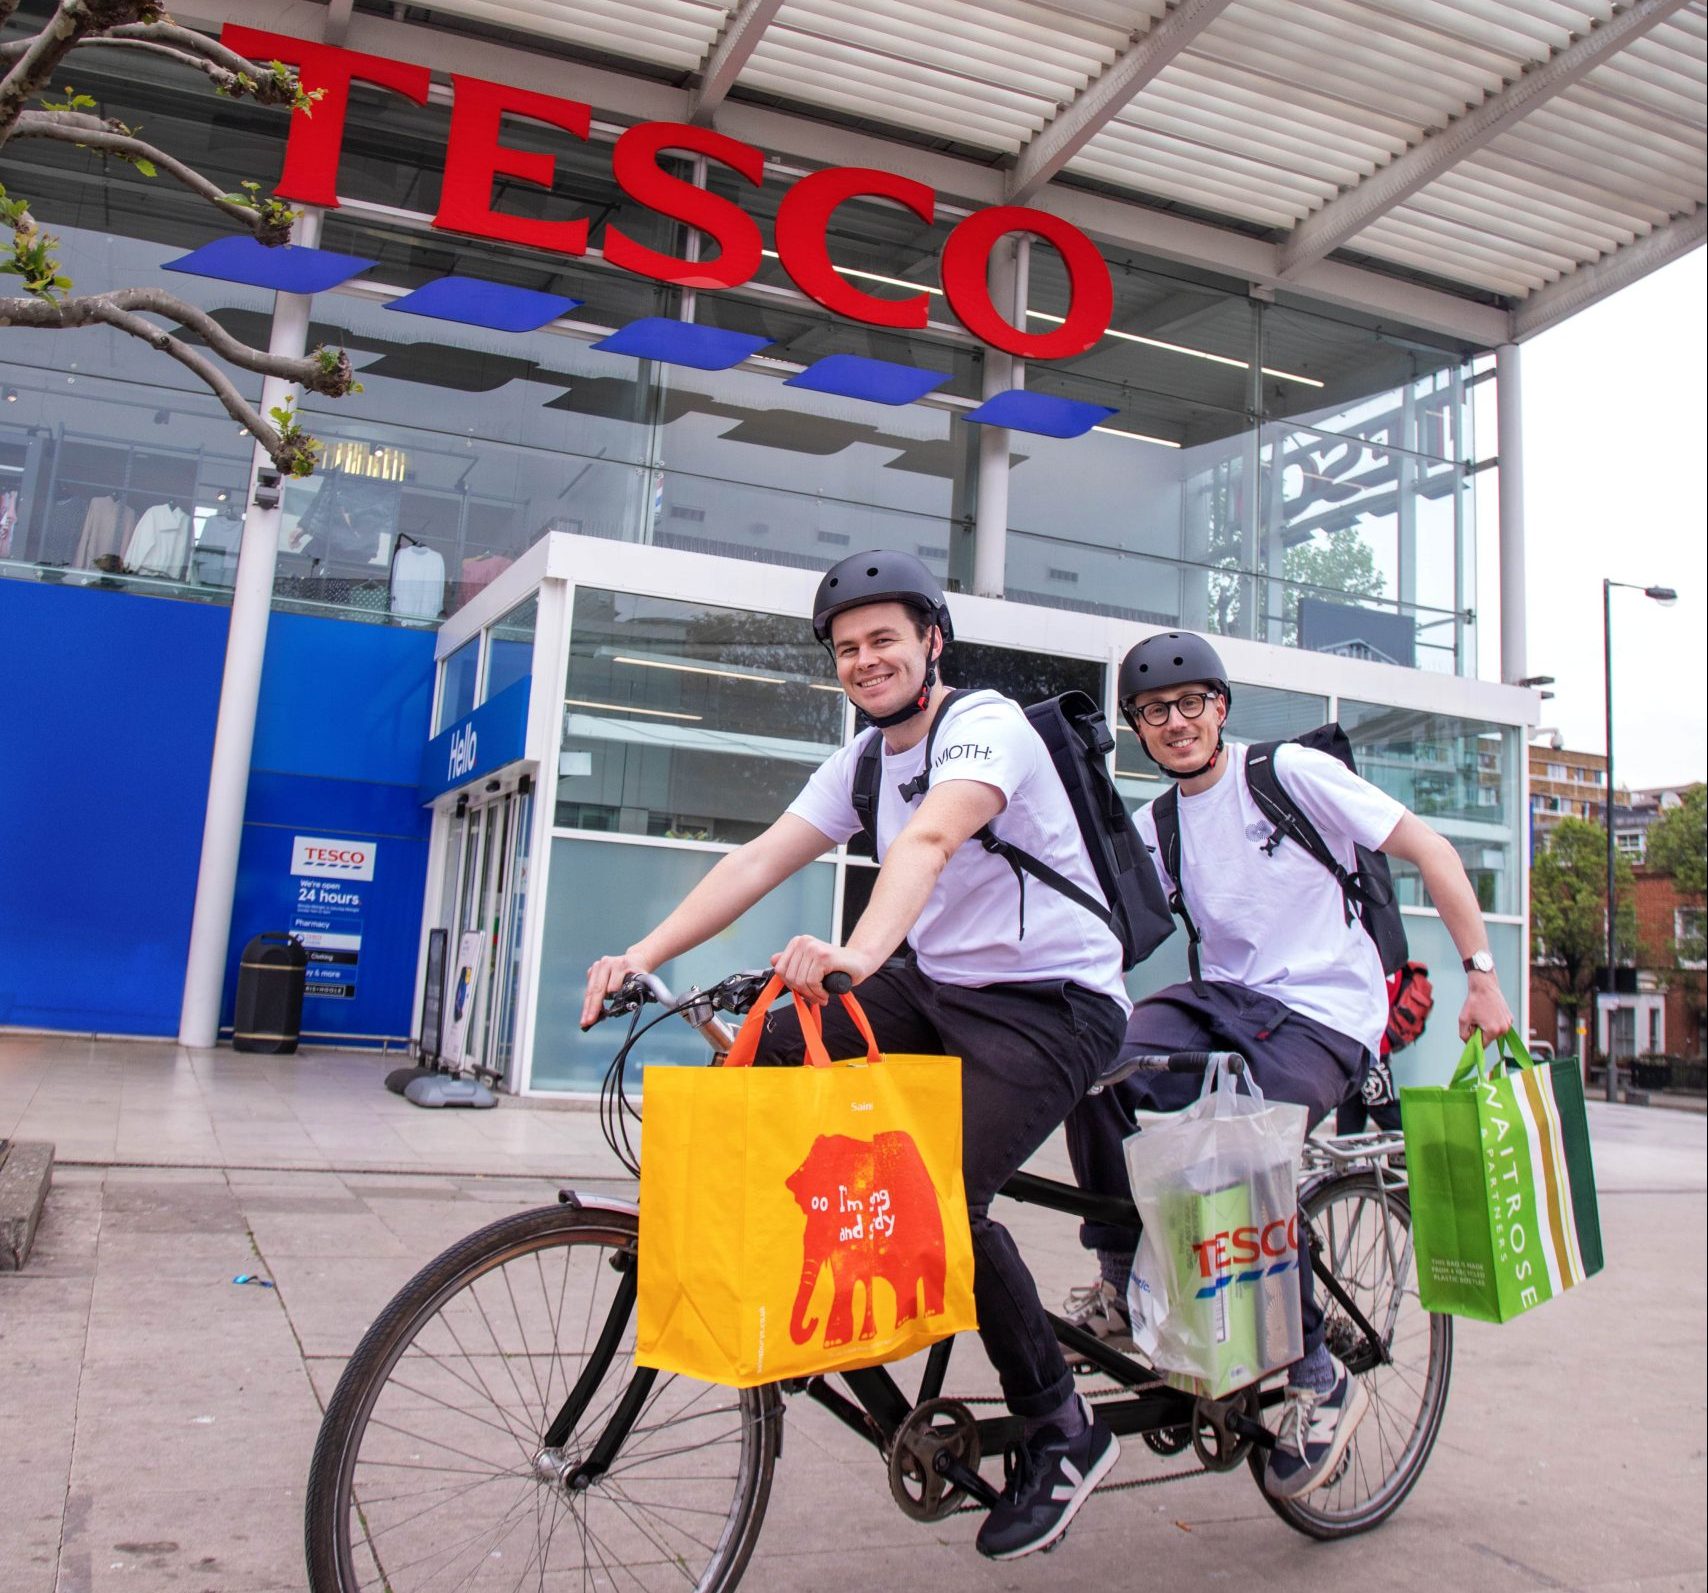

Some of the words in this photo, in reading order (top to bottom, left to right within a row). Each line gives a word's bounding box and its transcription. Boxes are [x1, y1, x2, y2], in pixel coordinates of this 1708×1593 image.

[221, 22, 1114, 360] TESCO
[304, 847, 365, 864] TESCO
[298, 887, 316, 901] 24
[321, 882, 341, 891] open
[295, 918, 330, 931] Pharmacy
[320, 970, 341, 978] more
[1481, 1082, 1538, 1309] WAITROSE
[1486, 1147, 1508, 1262] PARTNERS
[839, 1214, 864, 1242] and
